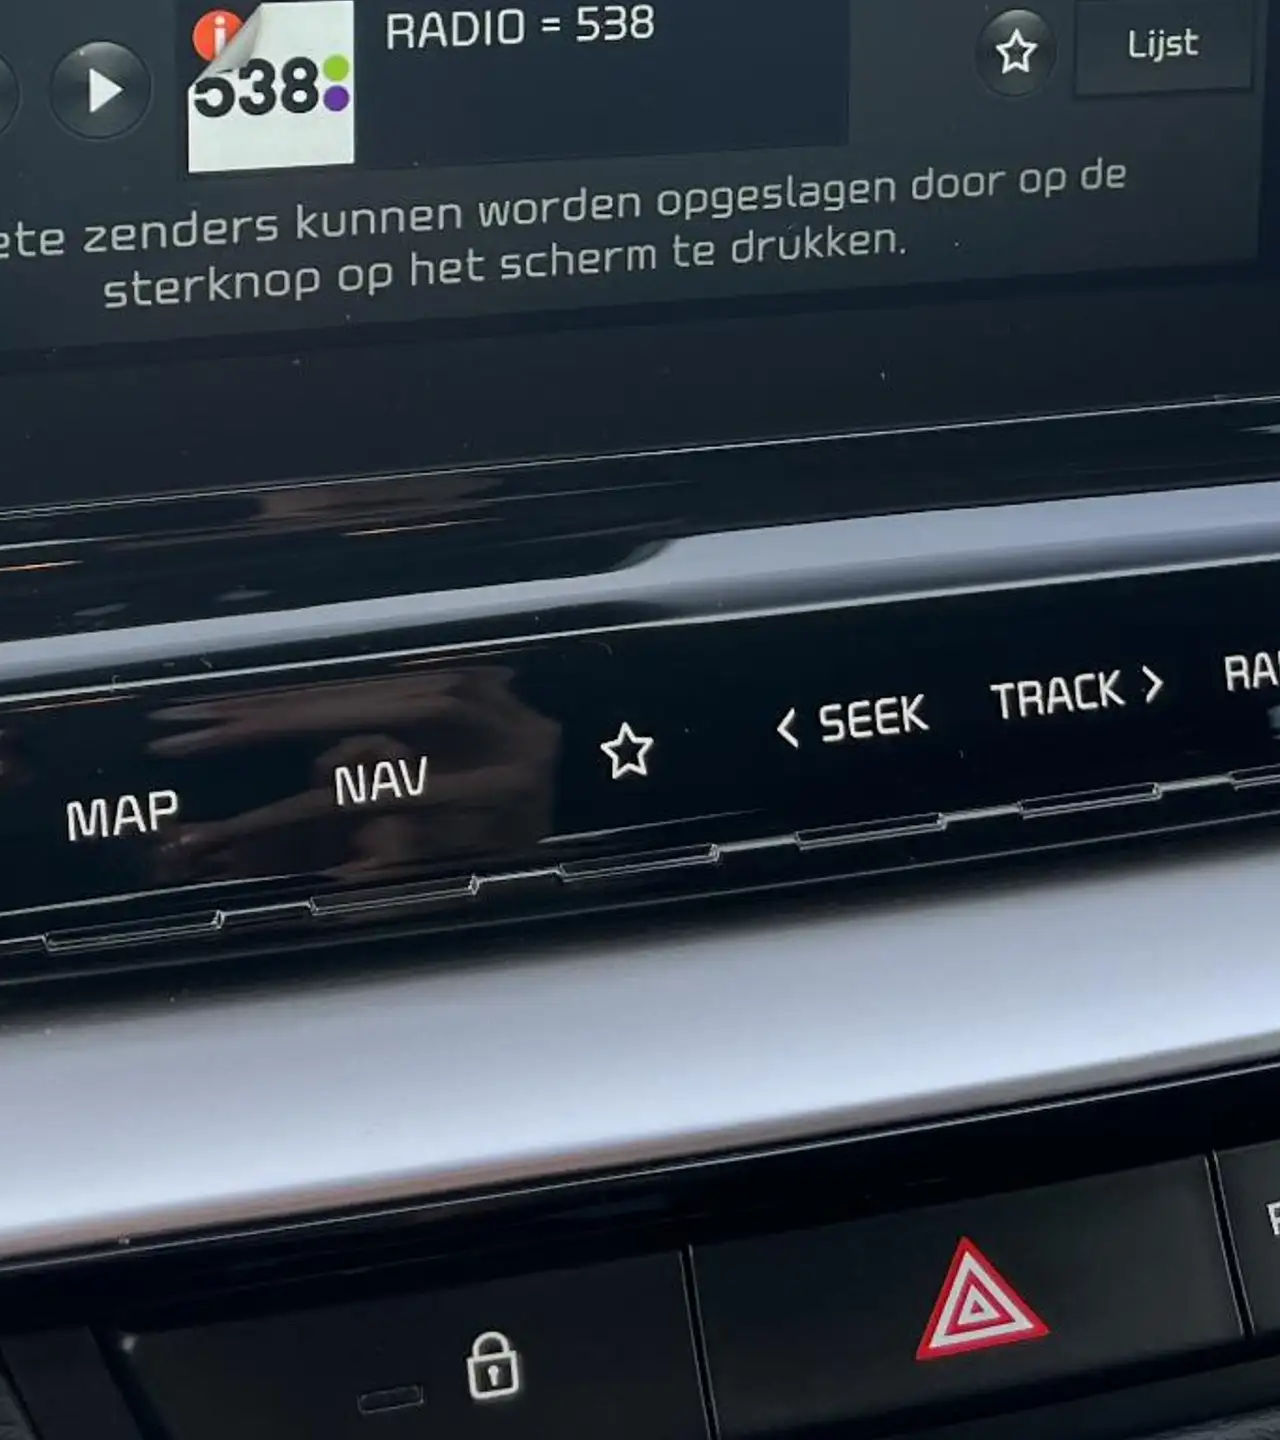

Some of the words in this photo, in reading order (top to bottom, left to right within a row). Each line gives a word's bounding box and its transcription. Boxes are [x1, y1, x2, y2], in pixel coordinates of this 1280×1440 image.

[387, 8, 525, 50] RADIO
[541, 17, 561, 32] =
[576, 4, 655, 42] 538
[1129, 28, 1199, 63] Lijst
[192, 55, 320, 119] 538
[83, 210, 278, 253] zenders
[296, 203, 462, 239] kunnen
[478, 186, 641, 227] worden
[657, 174, 896, 221] opgeslagen
[911, 166, 1006, 200] door
[1019, 167, 1067, 198] op
[1081, 156, 1127, 190] de
[103, 265, 320, 309] sterknop
[338, 262, 393, 296] op
[411, 249, 485, 286] het
[500, 242, 656, 280] scherm
[672, 235, 715, 268] te
[731, 224, 906, 264] drukken.
[819, 693, 929, 742] SEEK
[990, 669, 1126, 720] TRACK
[335, 755, 427, 806] NAV
[66, 789, 178, 842] MAP
